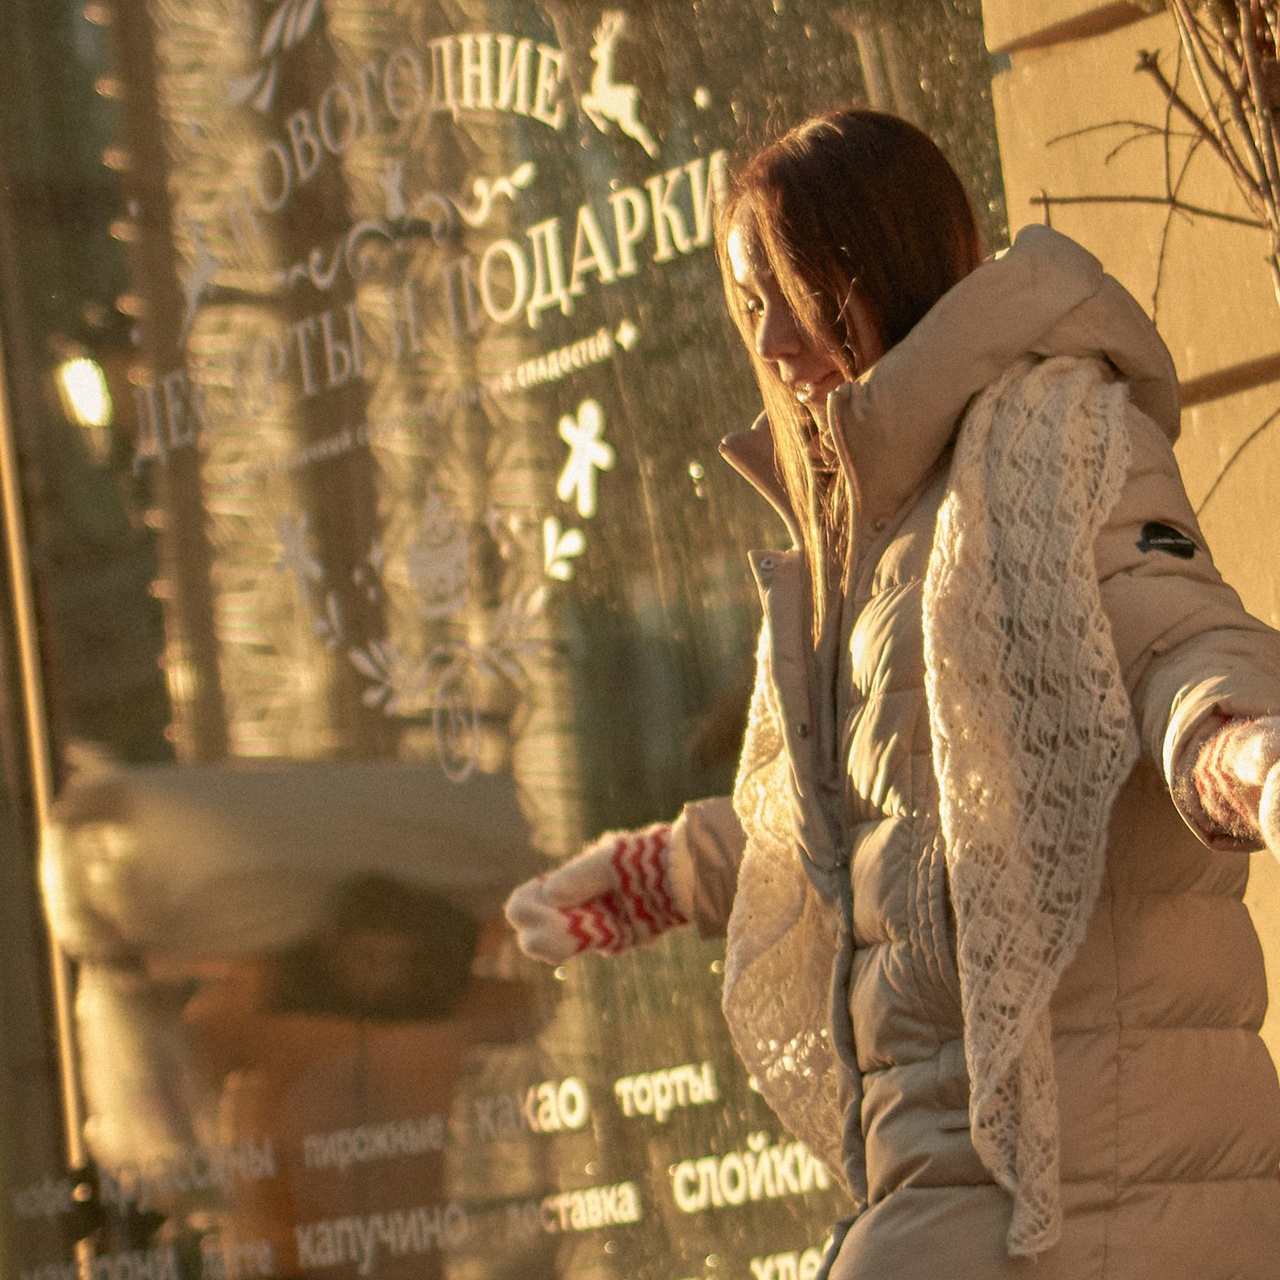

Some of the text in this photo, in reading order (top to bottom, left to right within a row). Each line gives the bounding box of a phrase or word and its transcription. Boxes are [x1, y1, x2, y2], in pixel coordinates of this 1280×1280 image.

[130, 308, 366, 477] ДЕРТЫ
[440, 148, 732, 340] ПОДАРКИ
[304, 1115, 446, 1174] пирожные
[472, 1076, 590, 1140] какао
[614, 1061, 718, 1122] торты
[294, 1203, 469, 1276] капучино
[672, 1132, 832, 1214] слойки
